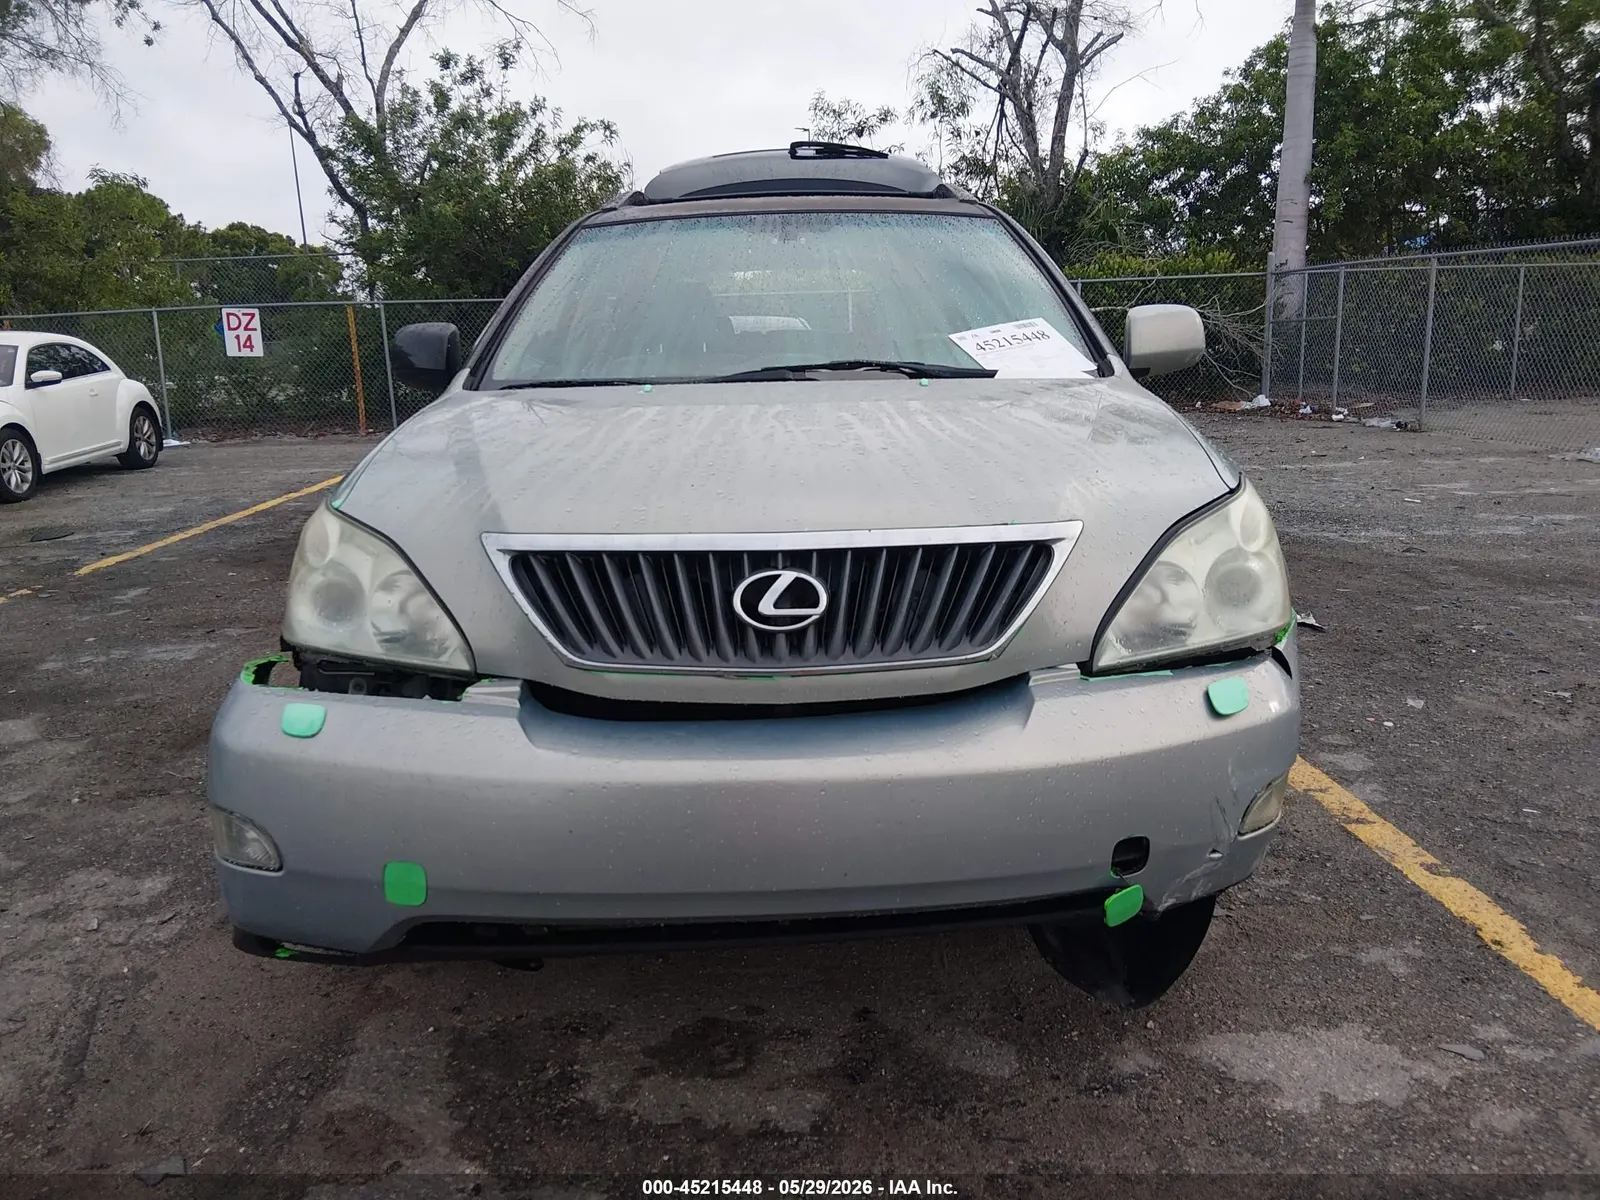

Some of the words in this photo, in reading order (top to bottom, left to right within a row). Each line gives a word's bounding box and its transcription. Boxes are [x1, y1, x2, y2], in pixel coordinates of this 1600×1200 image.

[226, 312, 257, 331] DZ
[234, 334, 255, 352] 14
[976, 330, 1051, 352] 45215448
